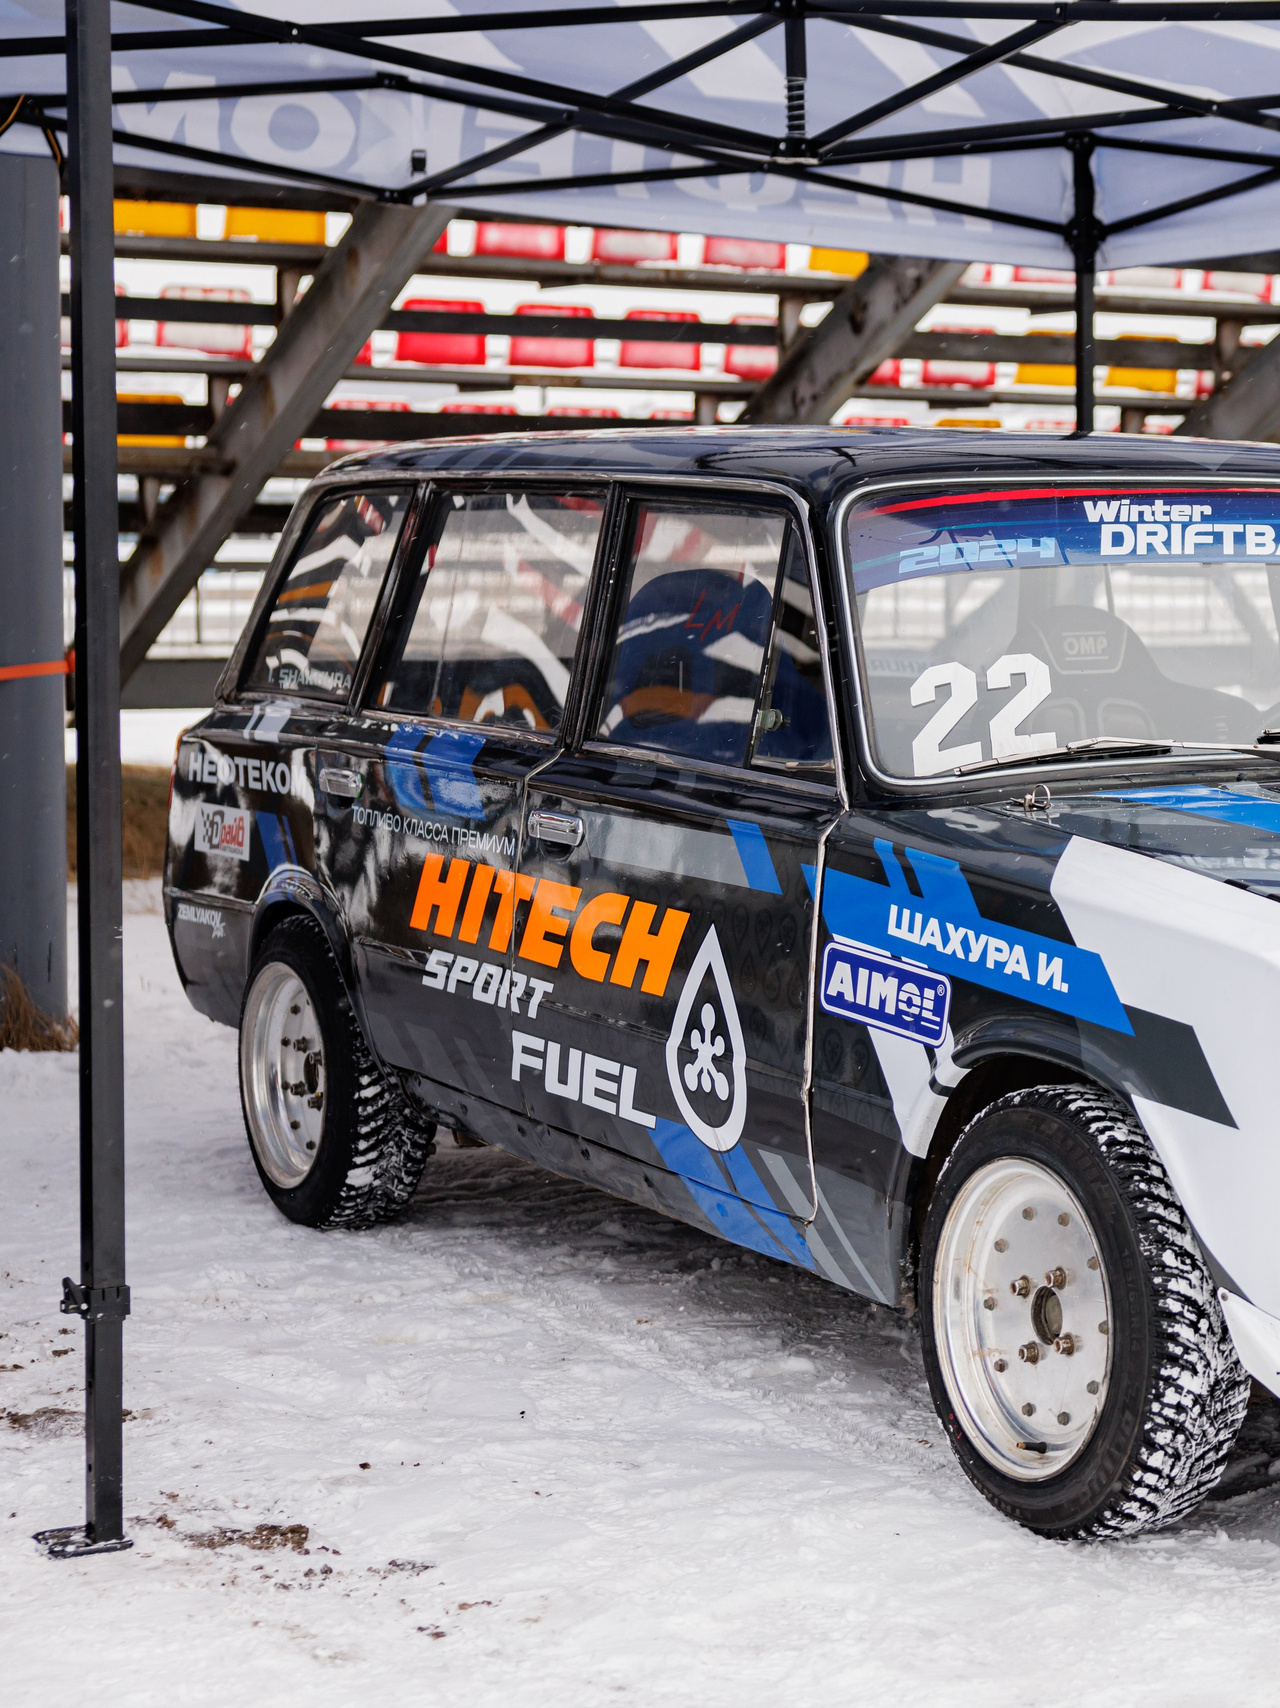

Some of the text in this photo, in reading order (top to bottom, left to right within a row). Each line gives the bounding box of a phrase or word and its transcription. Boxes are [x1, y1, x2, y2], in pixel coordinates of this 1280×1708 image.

[1084, 500, 1212, 523] Winter
[899, 537, 1056, 574] 2024
[1063, 636, 1108, 656] OMP
[910, 653, 1058, 777] 22
[352, 805, 516, 856] ТОПЛИВО КЛАССА ПРЕМИУМ
[409, 851, 692, 998] HITECH
[887, 903, 1069, 993] ШАХУРА И.
[422, 948, 555, 1019] SPORT
[826, 960, 942, 1031] AIMOL
[511, 1030, 657, 1130] FUEL
